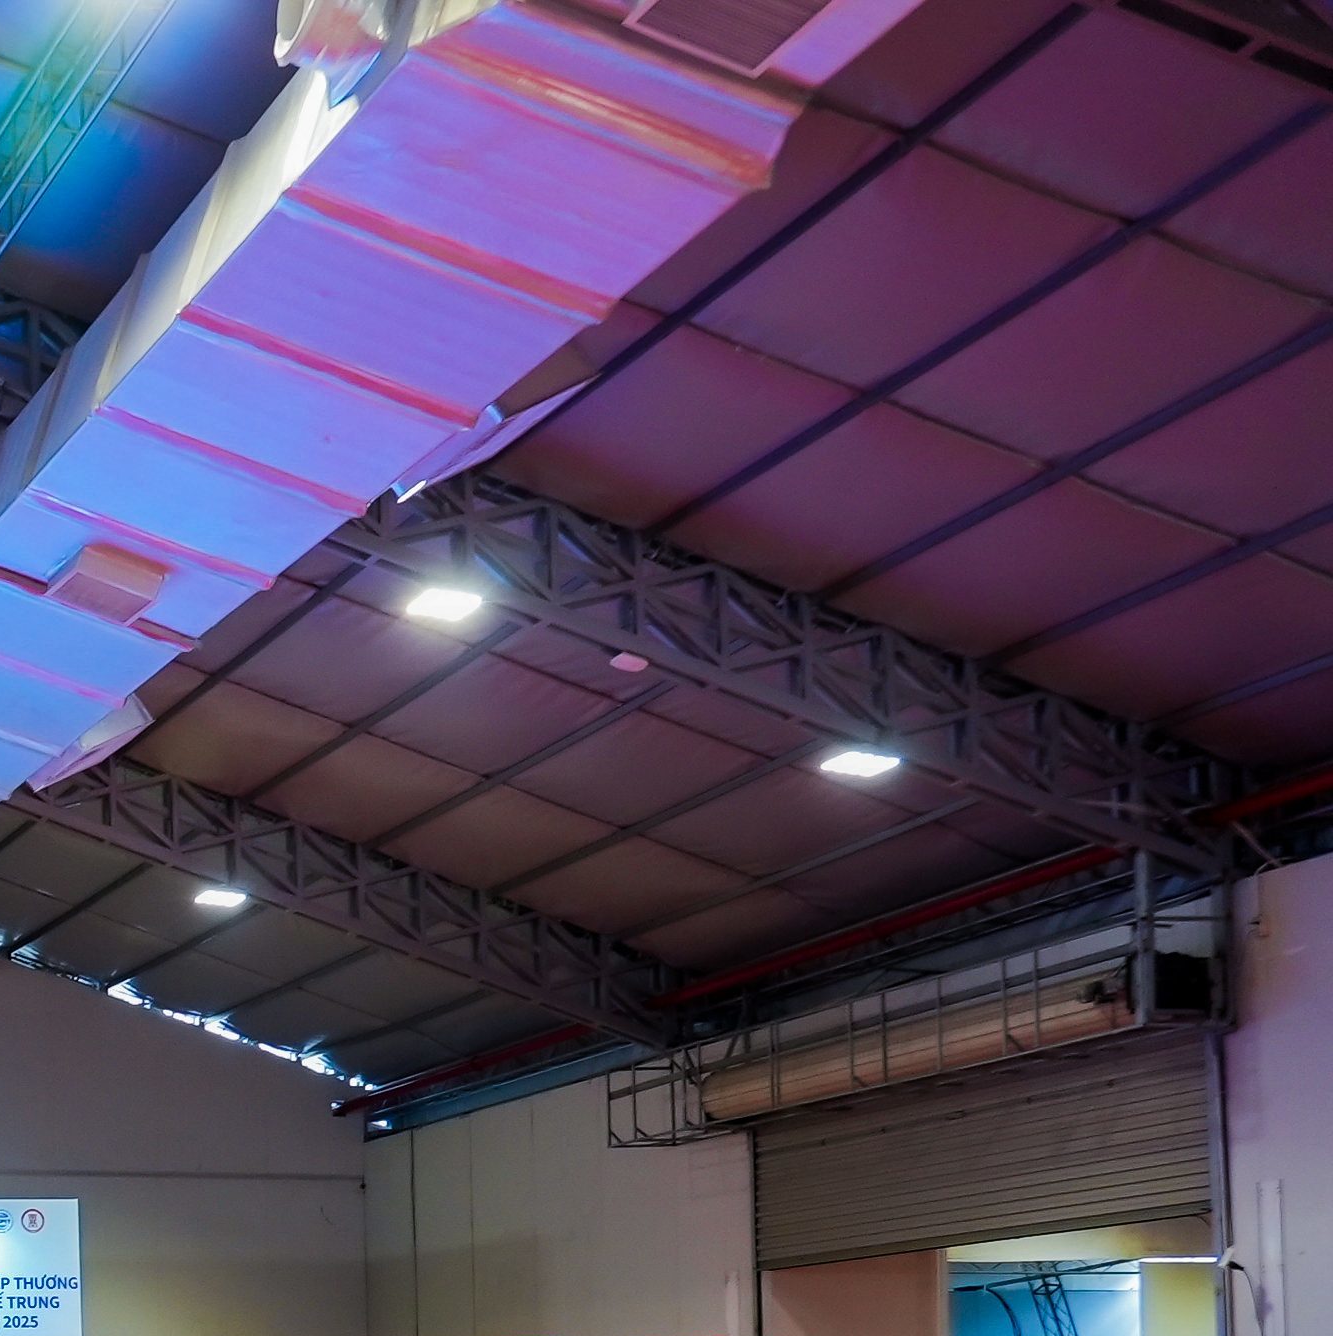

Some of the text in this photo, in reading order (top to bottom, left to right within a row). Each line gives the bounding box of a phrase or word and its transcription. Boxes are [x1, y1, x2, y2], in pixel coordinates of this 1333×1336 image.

[13, 1274, 79, 1290] THƯƠNG
[7, 1296, 60, 1310] TRUNG
[3, 1315, 39, 1329] 2025
